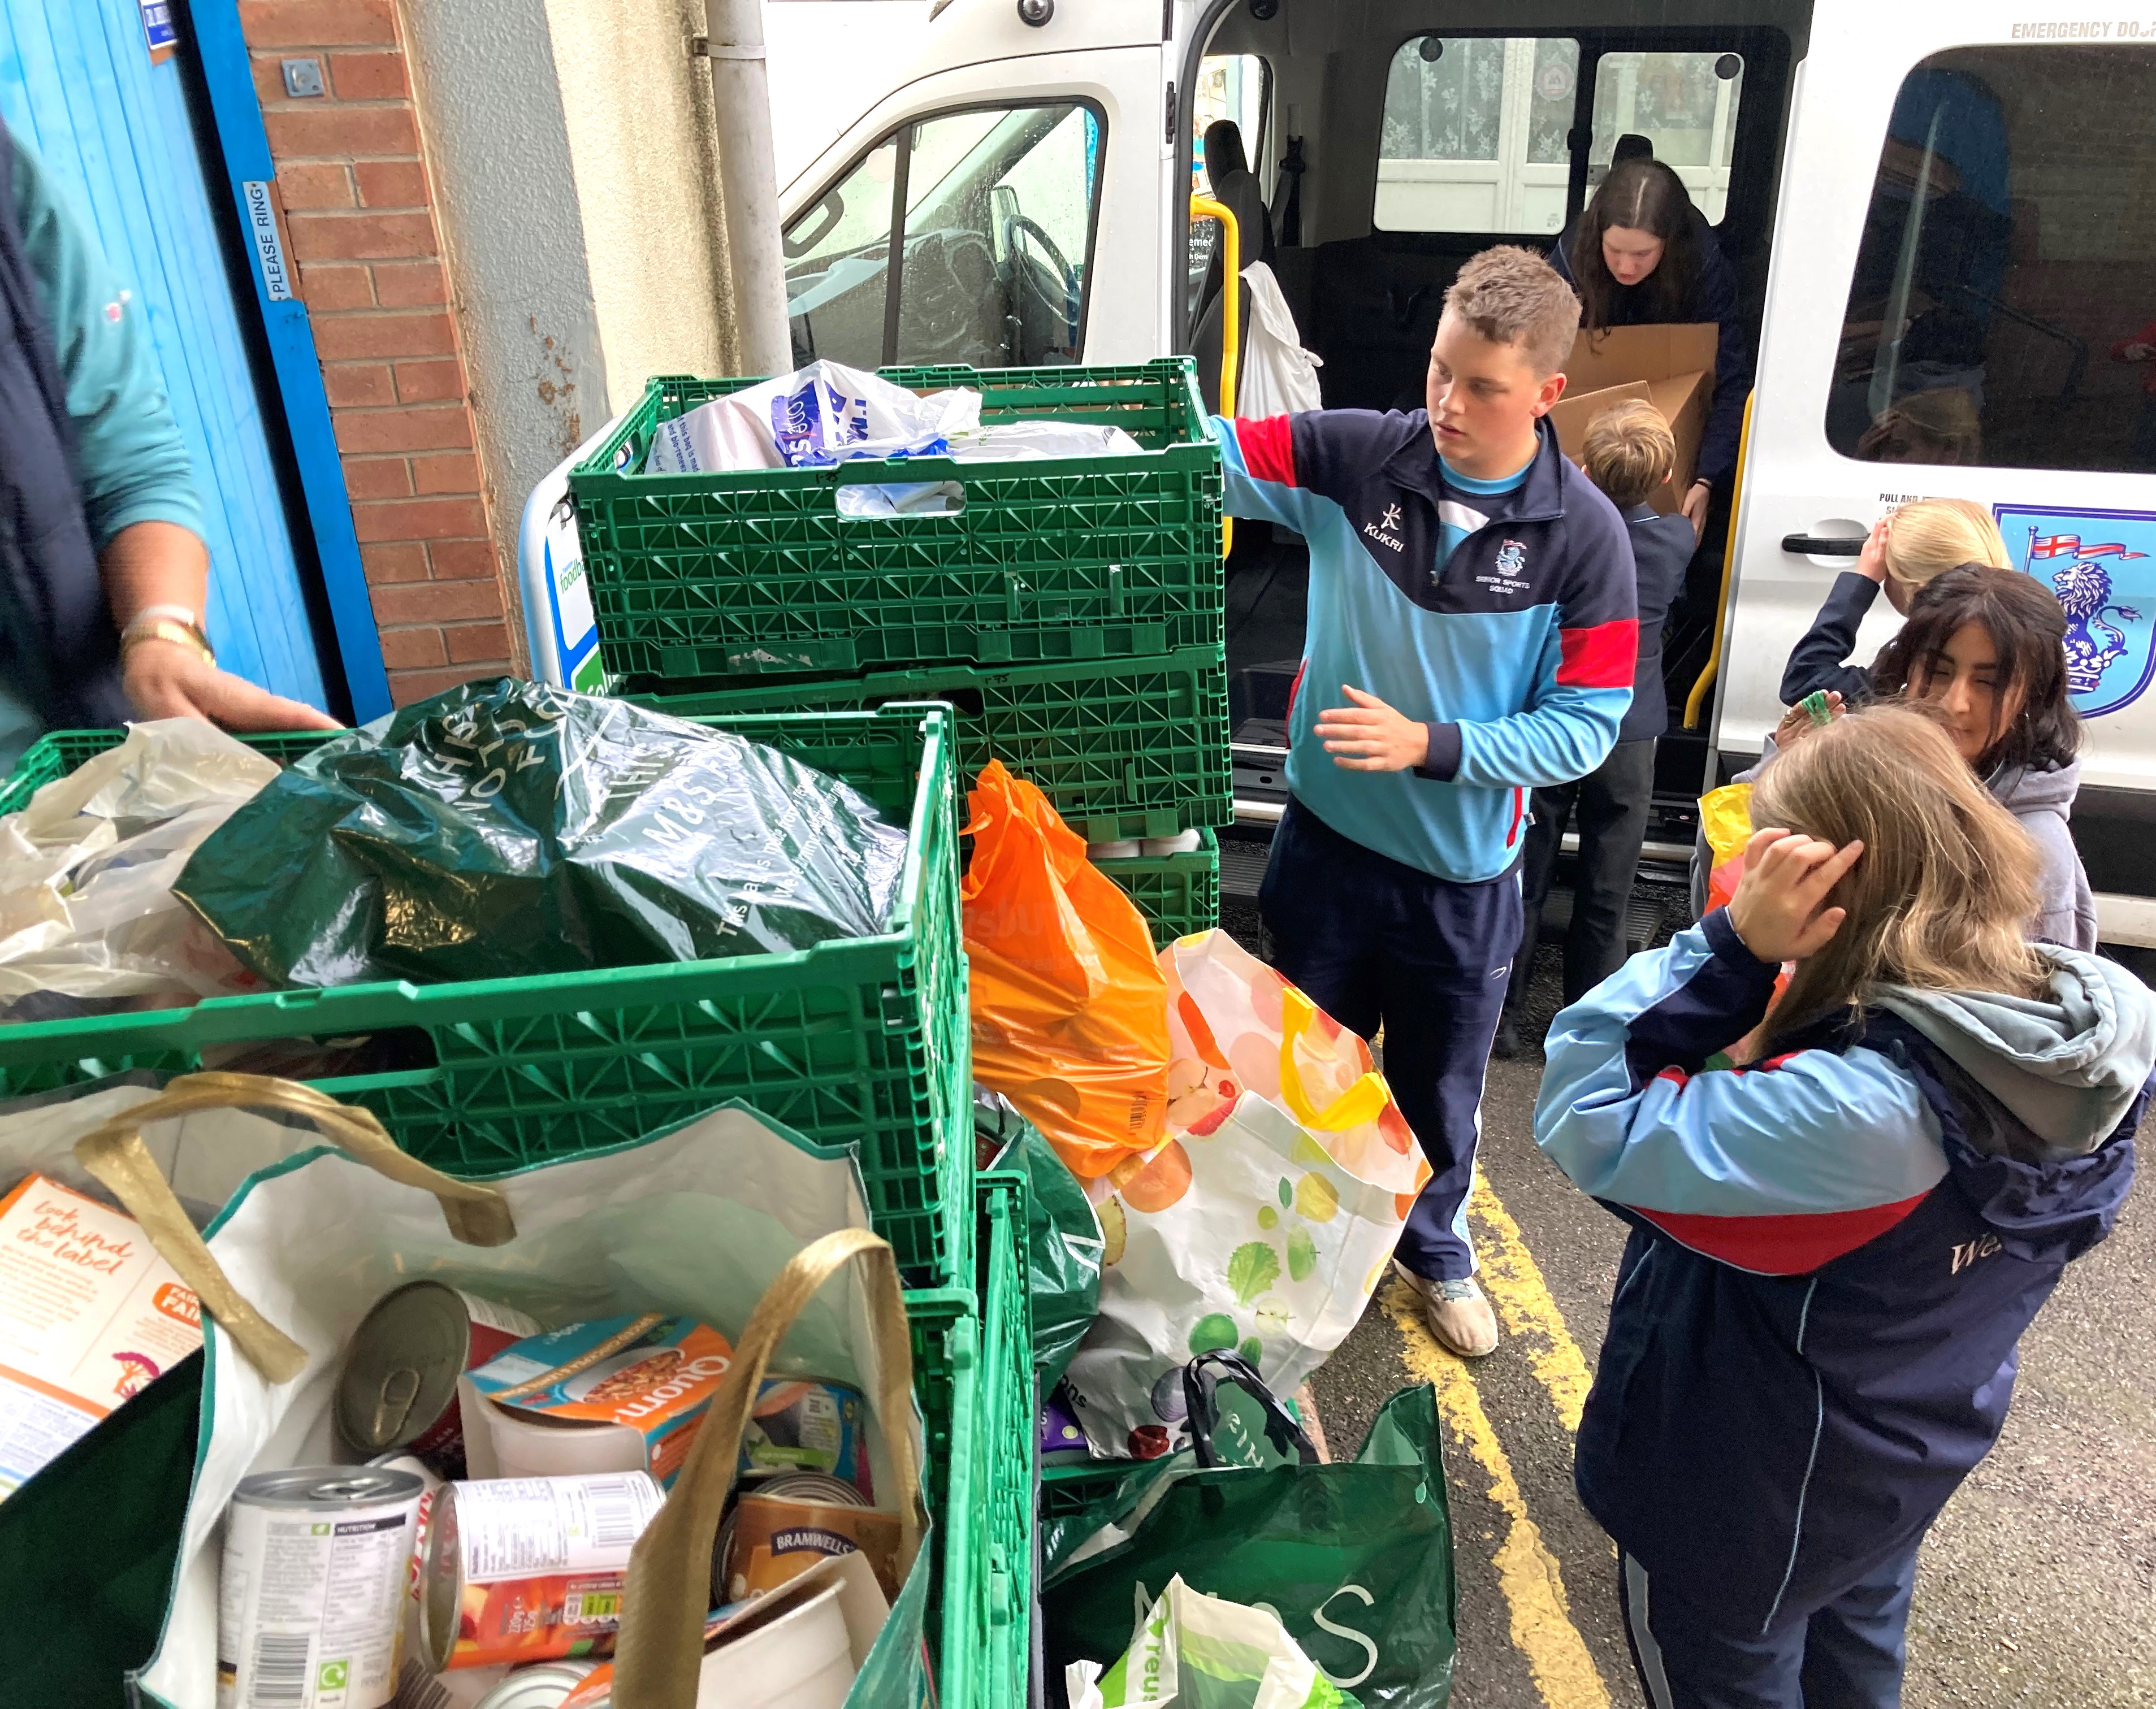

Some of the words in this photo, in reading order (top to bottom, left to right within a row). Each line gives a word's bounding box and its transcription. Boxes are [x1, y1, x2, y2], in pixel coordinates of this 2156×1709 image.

[2011, 21, 2112, 38] EMERGENCY
[250, 188, 270, 227] RING
[261, 234, 285, 293] PLEASE
[668, 424, 677, 436] and
[679, 422, 688, 437] this
[671, 435, 687, 472] bio-renewa
[684, 436, 692, 451] bag
[688, 449, 695, 458] is
[690, 458, 700, 472] mad
[1879, 493, 1899, 503] PULL
[1900, 495, 1918, 504] AND
[1363, 522, 1404, 553] KUKRI
[1503, 579, 1530, 589] SPORTS
[642, 776, 716, 854] M&S
[35, 1217, 134, 1257] behind
[17, 1228, 55, 1248] the
[53, 1242, 124, 1276] label
[615, 1355, 731, 1419] Quorn
[776, 1532, 848, 1554] BRAMWELLS
